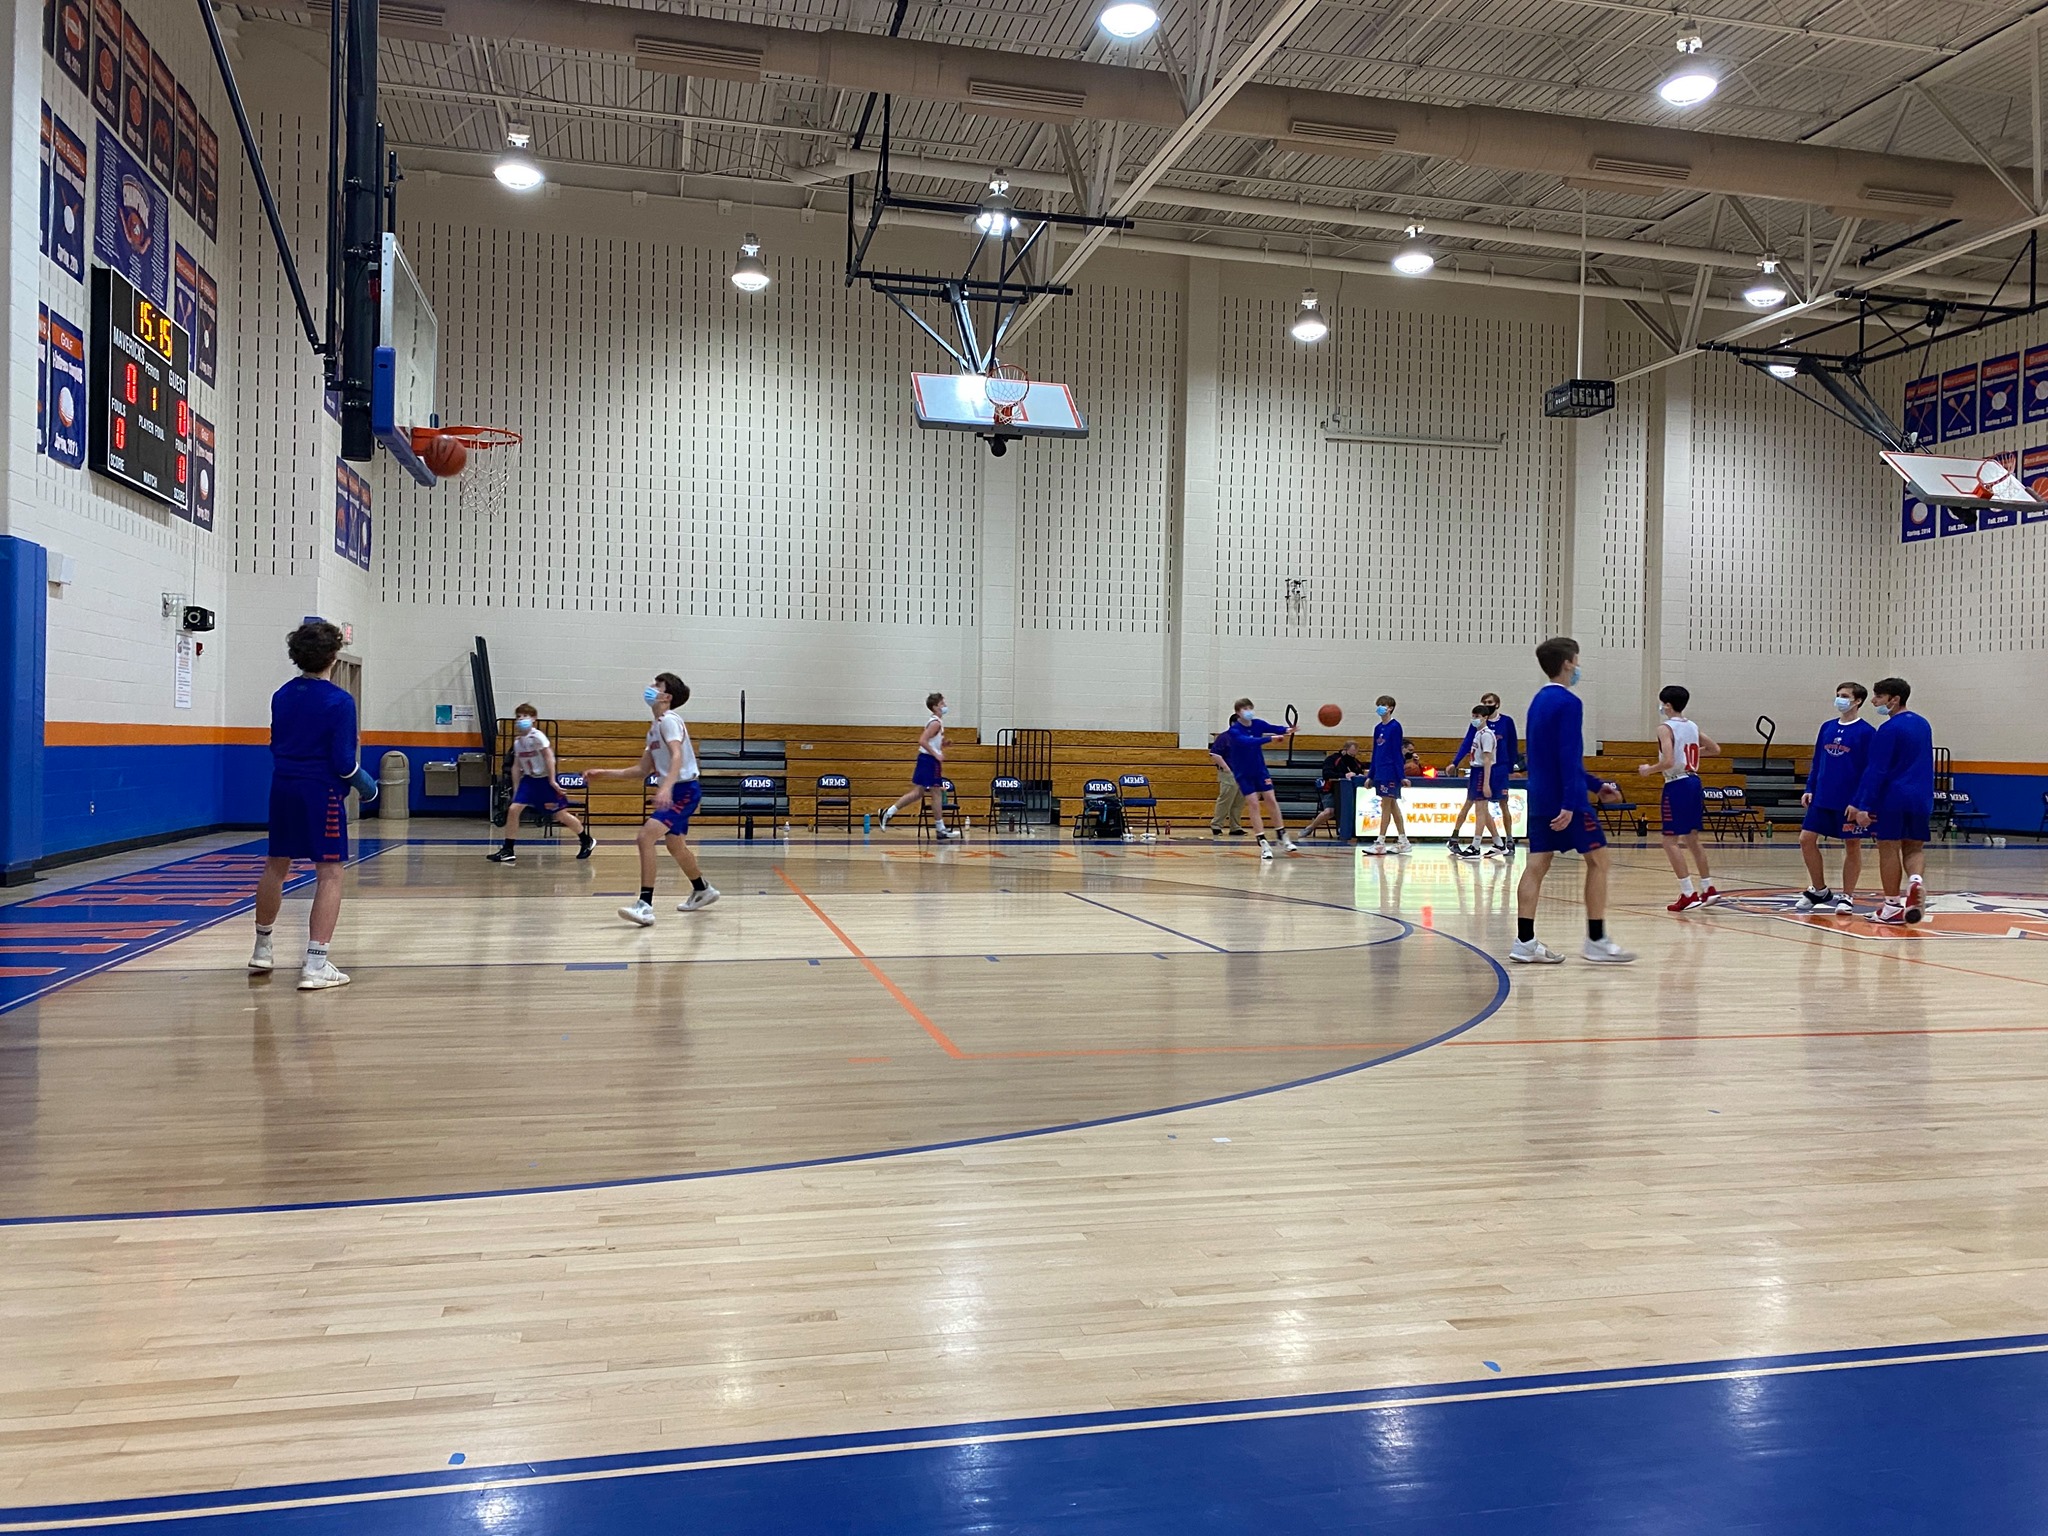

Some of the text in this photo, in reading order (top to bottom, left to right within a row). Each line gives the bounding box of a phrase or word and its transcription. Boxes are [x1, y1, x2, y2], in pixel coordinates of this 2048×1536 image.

[139, 301, 171, 359] 15:15
[61, 333, 73, 351] GOLF
[113, 326, 145, 366] MAVERICKS
[145, 361, 160, 382] PERIOD
[169, 370, 186, 396] GUEST
[111, 397, 127, 418] FOULS
[138, 414, 165, 442] PLAYER FOUL
[109, 453, 125, 472] SCORE
[143, 471, 157, 489] MATCH
[173, 487, 185, 503] SCORE
[1684, 743, 1700, 772] 10
[745, 779, 771, 788] MRMS
[821, 778, 846, 786] MRMS
[995, 780, 1018, 788] MRMS
[1088, 783, 1113, 791] MRMS
[1123, 776, 1145, 784] MRMS
[1703, 790, 1723, 799] MRMS
[1723, 789, 1743, 797] MRMS
[1950, 793, 1969, 801] MRMS
